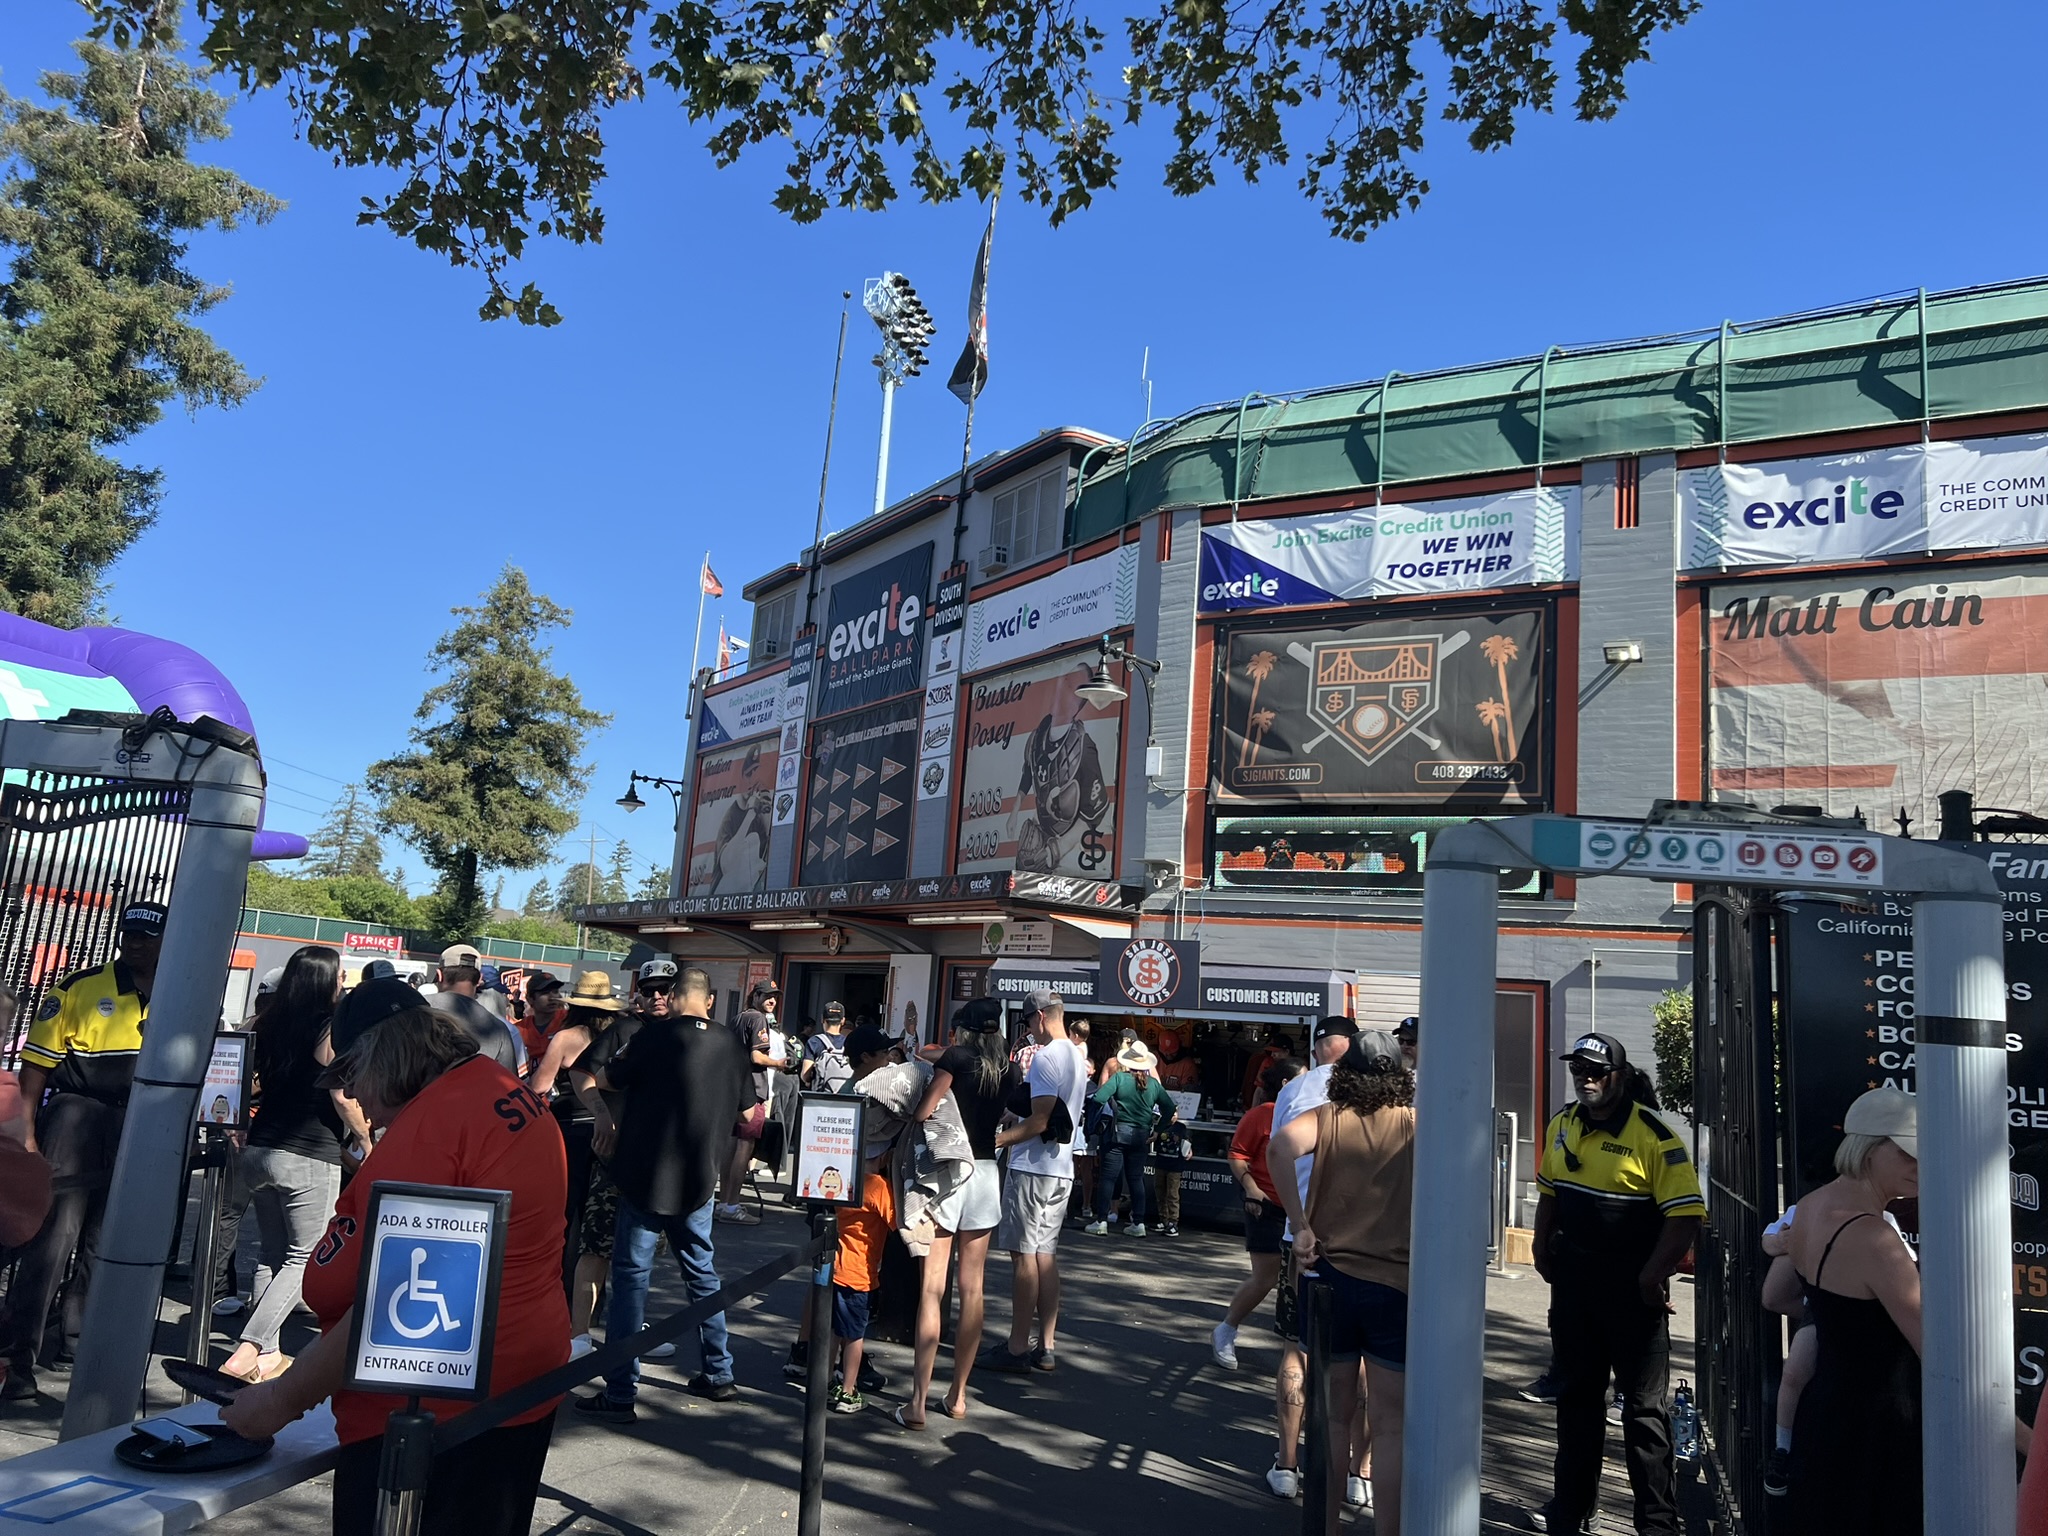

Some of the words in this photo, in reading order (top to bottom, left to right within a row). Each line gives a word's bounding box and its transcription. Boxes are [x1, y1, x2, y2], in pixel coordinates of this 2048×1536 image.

[1939, 482, 1976, 496] THE
[1743, 480, 1904, 529] excite
[1940, 496, 2008, 513] CREDIT
[1272, 533, 1311, 551] Join
[1317, 525, 1373, 545] Excite
[1380, 516, 1443, 537] Credit
[1451, 510, 1514, 531] Union
[1422, 538, 1459, 555] WE
[1466, 531, 1514, 552] WIN
[1386, 555, 1513, 581] TOGETHER
[940, 582, 962, 605] SOUTH
[1051, 598, 1061, 609] THE
[1061, 582, 1112, 606] COMMUNITY'S
[1203, 572, 1276, 602] excite
[934, 604, 964, 628] DIVISION
[1050, 608, 1070, 624] CREDIT
[1072, 600, 1098, 617] UNION
[1723, 595, 1842, 641] Matt
[1859, 586, 1986, 634] Cain
[829, 583, 920, 662] excite
[987, 603, 1041, 643] excite
[794, 642, 812, 659] NORTH
[830, 637, 913, 680] BALLPARK
[829, 679, 844, 690] home
[845, 674, 853, 684] of
[852, 672, 862, 682] the
[863, 668, 875, 679] San
[876, 663, 890, 675] Jose
[891, 656, 912, 669] Giants
[974, 680, 1031, 712] Buster
[738, 716, 756, 730] HOME
[757, 710, 773, 724] TEAM
[701, 726, 719, 743] excite
[970, 721, 1015, 750] Posey
[1242, 767, 1310, 782] SJGIANTS.COM
[969, 786, 1002, 820] 2008
[966, 828, 999, 862] 2009
[872, 884, 891, 899] excite
[919, 880, 939, 895] excite
[970, 876, 991, 890] excite
[1037, 878, 1073, 895] excite
[668, 896, 706, 914] WELCOME
[709, 897, 720, 912] TO
[722, 894, 754, 912] EXCITE
[756, 890, 808, 909] BALLPARK
[830, 887, 847, 900] excite
[126, 908, 164, 924] SECURITY
[350, 935, 395, 949] STRIKE
[1125, 940, 1146, 960] SAN
[1150, 941, 1176, 964] JOSE
[998, 979, 1051, 993] CUSTOMER
[1052, 982, 1094, 996] SERVICE
[1126, 988, 1171, 1005] GIANTS
[1207, 987, 1268, 1005] CUSTOMER
[1269, 990, 1321, 1008] SERVICE
[812, 1125, 831, 1134] TICKET
[831, 1127, 856, 1136] BARCODE
[817, 1115, 838, 1125] PLEASE
[838, 1117, 853, 1126] HAVE
[817, 1135, 834, 1144] READY
[1600, 1139, 1634, 1158] SECURITY
[806, 1145, 830, 1154] SCANNED
[830, 1146, 841, 1155] FOR
[1189, 1180, 1210, 1192] GIANTS
[1193, 1171, 1212, 1182] UNION
[1212, 1173, 1221, 1183] OF
[1221, 1174, 1233, 1185] THE
[380, 1215, 408, 1231] ADA
[412, 1216, 423, 1232] &
[427, 1218, 488, 1235] STROLLER
[364, 1356, 434, 1376] ENTRANCE
[437, 1361, 473, 1378] ONLY
